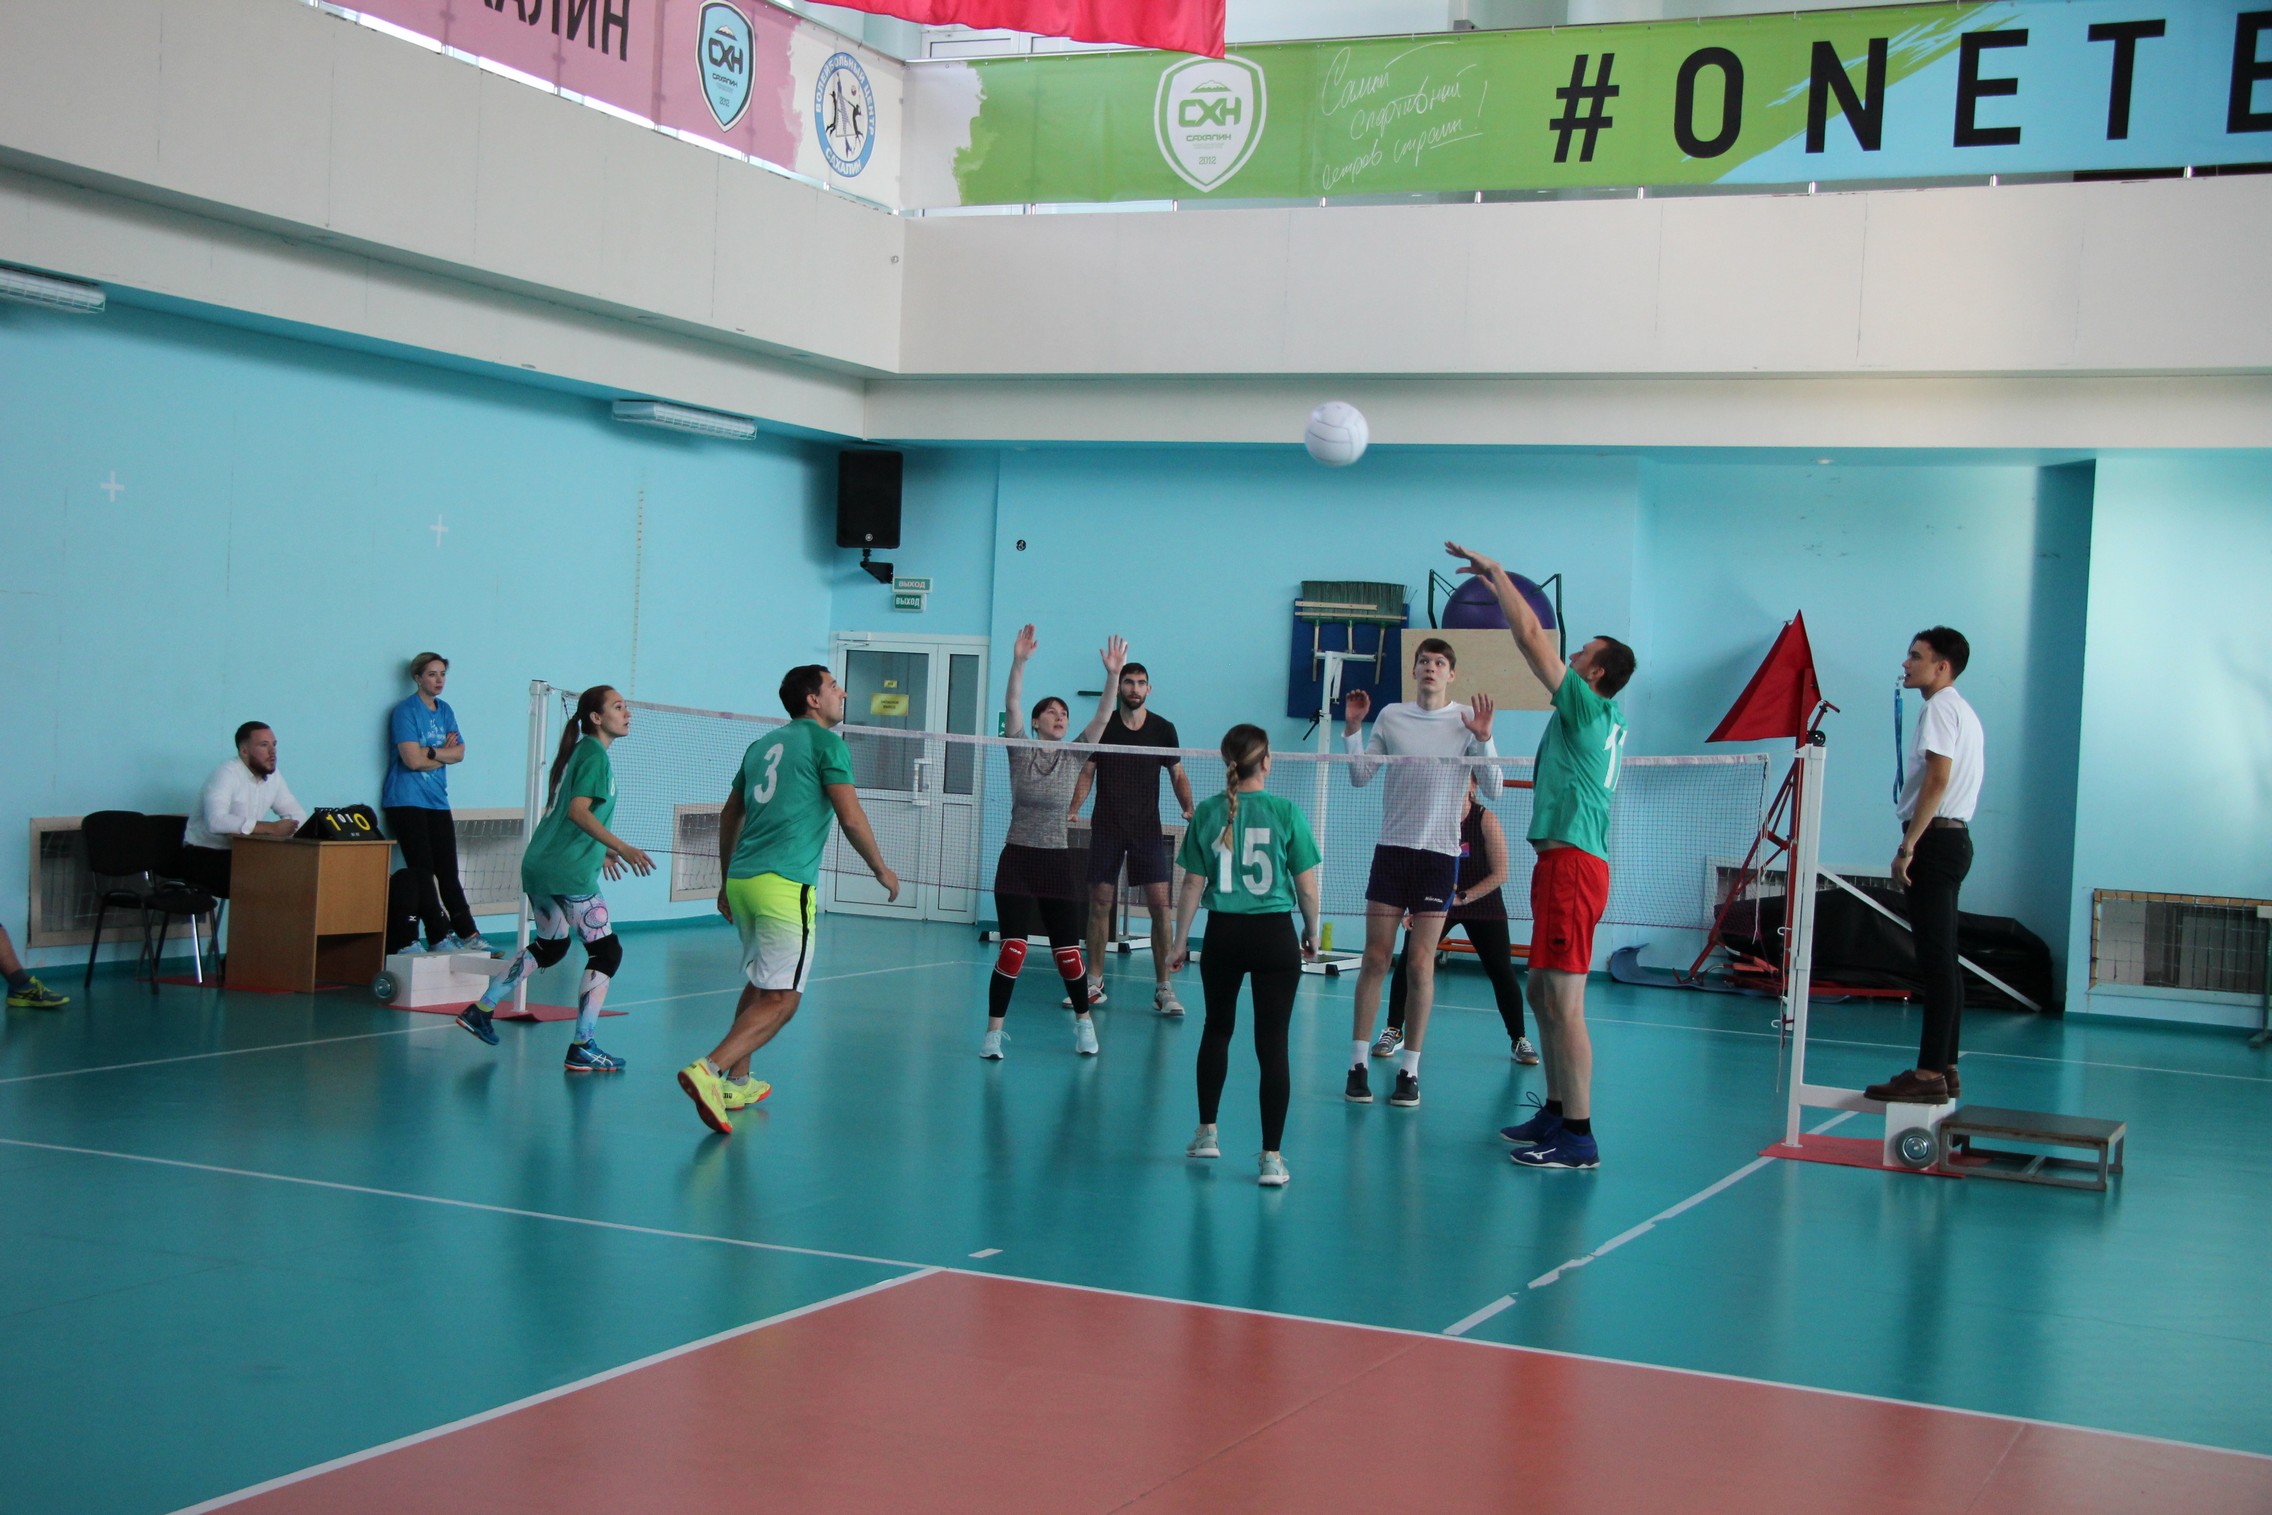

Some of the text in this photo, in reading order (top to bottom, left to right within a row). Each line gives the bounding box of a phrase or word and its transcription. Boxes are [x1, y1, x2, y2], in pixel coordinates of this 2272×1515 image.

[815, 55, 875, 136] ВОЛЕЙБОЛЬНЫЙ ЦЕНТР
[1178, 96, 1242, 128] СХН
[1186, 133, 1232, 142] САХАЛИН
[825, 147, 862, 176] САХАЛИН
[1198, 156, 1217, 165] 2012
[898, 581, 926, 589] ВЫХОД
[896, 597, 920, 607] ВЫХОД
[753, 743, 784, 804] 3
[326, 814, 341, 831] 1
[353, 813, 371, 831] 0
[1211, 826, 1273, 896] 15
